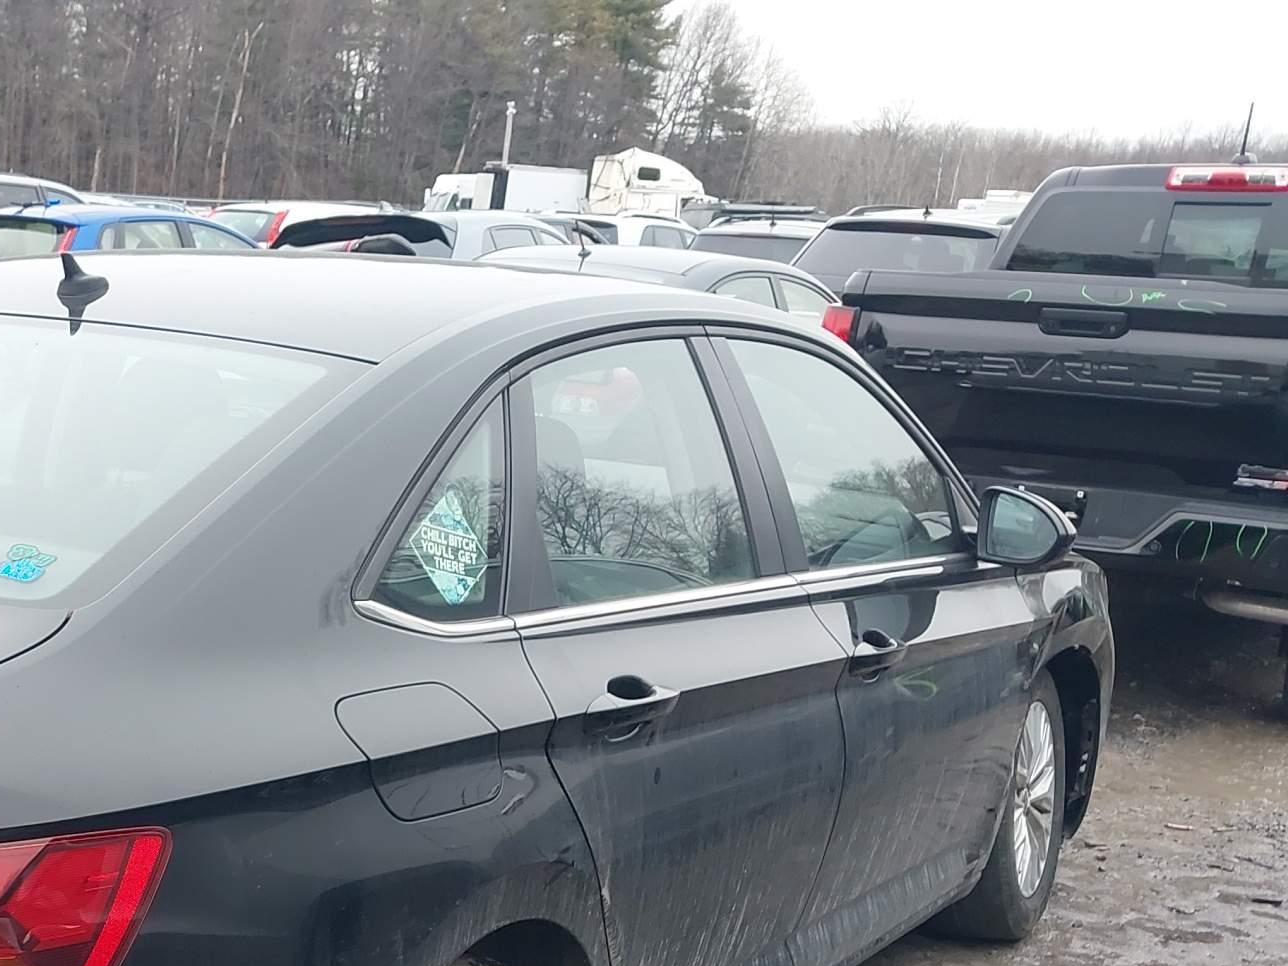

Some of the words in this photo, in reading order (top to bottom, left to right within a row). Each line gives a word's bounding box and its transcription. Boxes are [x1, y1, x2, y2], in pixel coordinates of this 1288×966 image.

[421, 527, 448, 544] CHILL
[449, 533, 477, 552] BITCH
[421, 539, 455, 560] YOU'LL
[457, 549, 477, 565] GET
[433, 556, 466, 574] THERE
